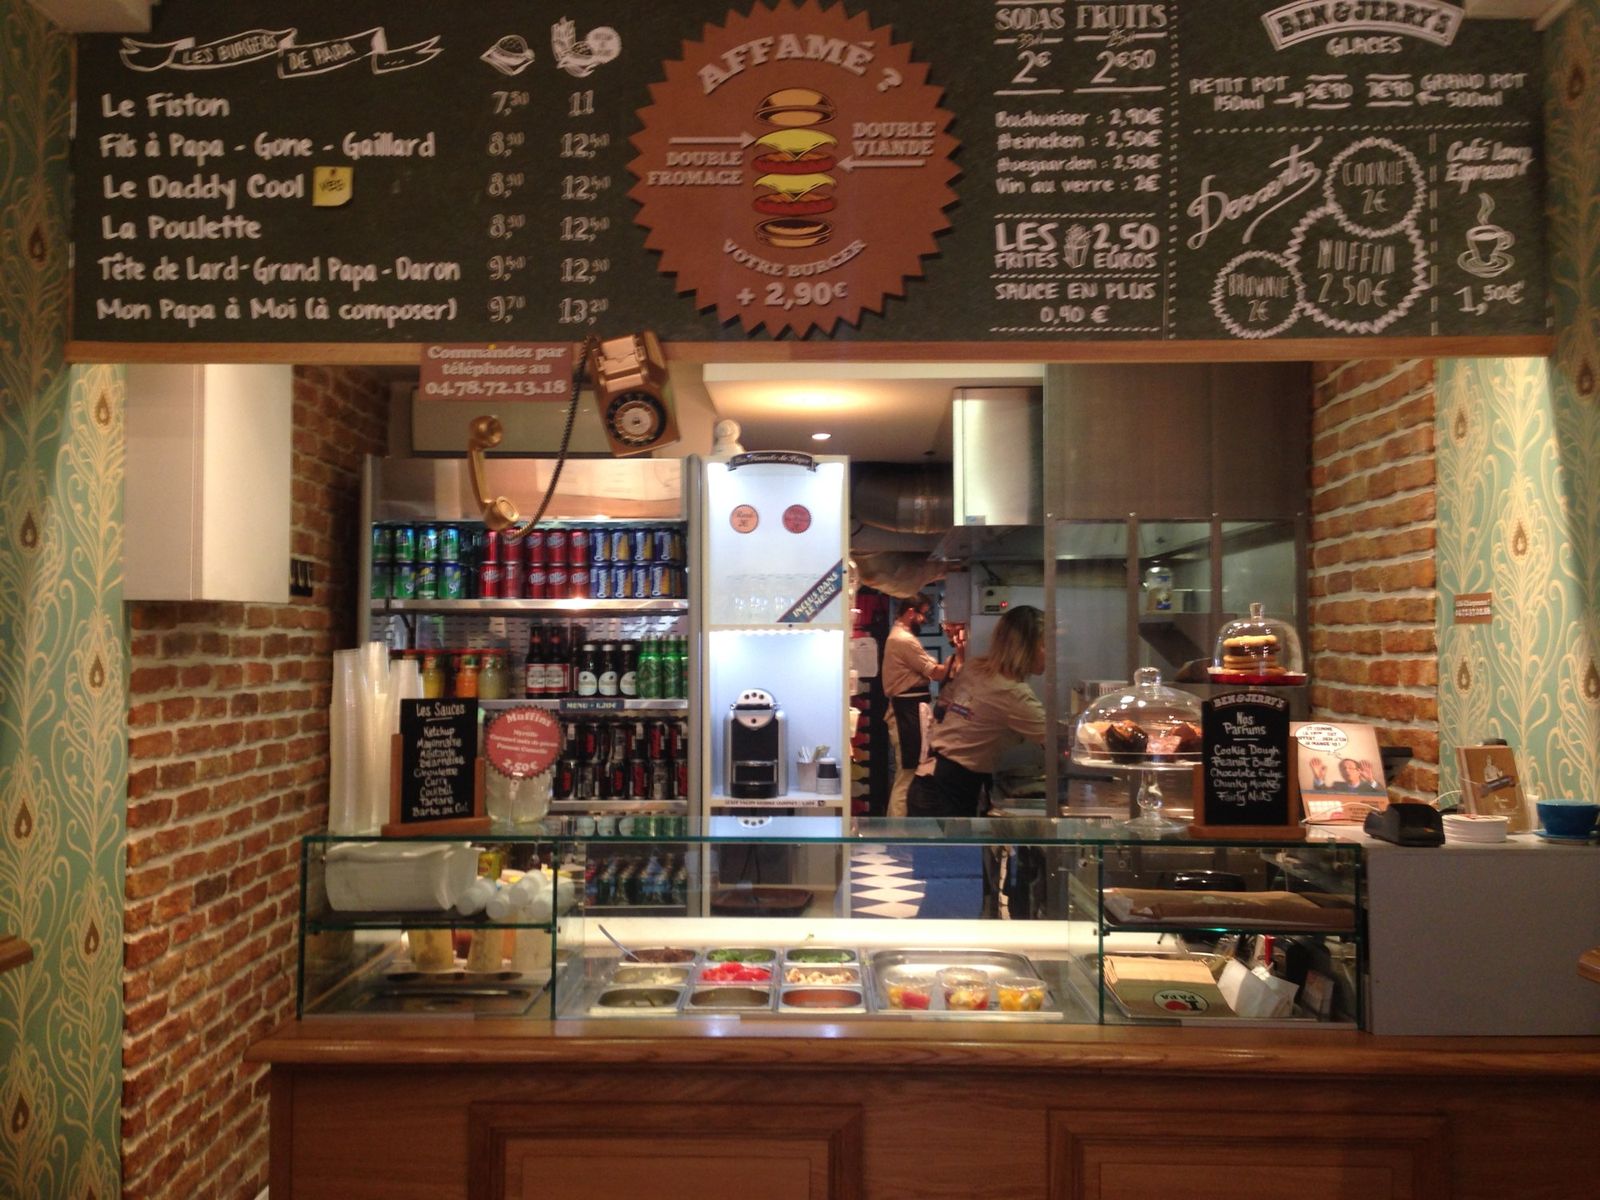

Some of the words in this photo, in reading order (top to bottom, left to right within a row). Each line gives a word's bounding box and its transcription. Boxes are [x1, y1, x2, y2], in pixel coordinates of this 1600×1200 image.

[995, 7, 1066, 31] SODAS
[1075, 4, 1168, 29] FRUITS
[1277, 4, 1329, 38] BEN
[1326, 36, 1404, 57] GLACES
[697, 33, 875, 95] AFFAMÉ
[877, 67, 903, 92] ?
[1011, 50, 1052, 84] 2€
[1090, 49, 1157, 84] 2€50
[1189, 77, 1248, 95] PETIT
[1251, 76, 1291, 93] POT
[1420, 73, 1485, 91] GRAND
[1489, 72, 1528, 89] POT
[102, 93, 136, 118] Le
[147, 92, 231, 117] Fiston
[568, 89, 595, 117] 11
[852, 121, 937, 138] DOUBLE
[1105, 129, 1163, 150] 2,50€
[99, 132, 137, 158] Fils
[145, 131, 161, 158] à
[169, 132, 225, 167] Papa
[254, 131, 314, 160] Gone
[342, 131, 436, 161] Gaillard
[852, 140, 935, 156] VIANDE
[666, 152, 743, 167] DOUBLE
[1112, 153, 1162, 173] 2,50€
[647, 170, 743, 187] FROMAGE
[1342, 160, 1406, 186] COOKIE
[103, 174, 137, 199] Le
[148, 173, 237, 210] Daddy
[247, 173, 305, 199] Cool
[995, 178, 1026, 194] Vin
[1030, 180, 1056, 194] au
[1061, 179, 1115, 193] verre
[1362, 188, 1387, 215] 2€
[102, 215, 137, 240] La
[148, 214, 262, 240] Poulette
[995, 222, 1059, 251] LES
[1091, 222, 1161, 254] 2,50
[723, 238, 785, 277] VOTRE
[787, 239, 868, 278] BURGER
[994, 252, 1060, 270] FRITES
[1093, 252, 1158, 270] EUROS
[1317, 238, 1396, 275] MUFFIN
[97, 252, 147, 281] Tête
[153, 255, 181, 281] de
[328, 256, 378, 291] Papa
[395, 256, 461, 281] Daron
[764, 281, 849, 311] 2,90€
[994, 282, 1060, 300] SAUCE
[1067, 282, 1099, 299] EN
[1105, 282, 1157, 300] PLUS
[1227, 272, 1289, 298] BROWNIE
[1453, 280, 1526, 316] 1,50€
[97, 298, 152, 320] Mon
[159, 298, 216, 328] Papa
[225, 297, 241, 320] à
[250, 298, 298, 320] Moi
[338, 297, 458, 329] composer)
[427, 345, 533, 360] Commandez
[535, 346, 566, 361] par
[441, 361, 529, 377] téléphone
[530, 364, 551, 375] au
[425, 379, 567, 396] 04.78.72.13.18
[816, 572, 838, 594] DANS
[416, 703, 431, 717] Les
[434, 702, 466, 716] Sauces
[506, 712, 551, 727] Muffins
[1236, 711, 1254, 725] Nos
[423, 726, 456, 739] Ketchup
[1222, 722, 1267, 735] Parfums
[1214, 744, 1246, 756] Cookie
[1248, 744, 1279, 760] Dough
